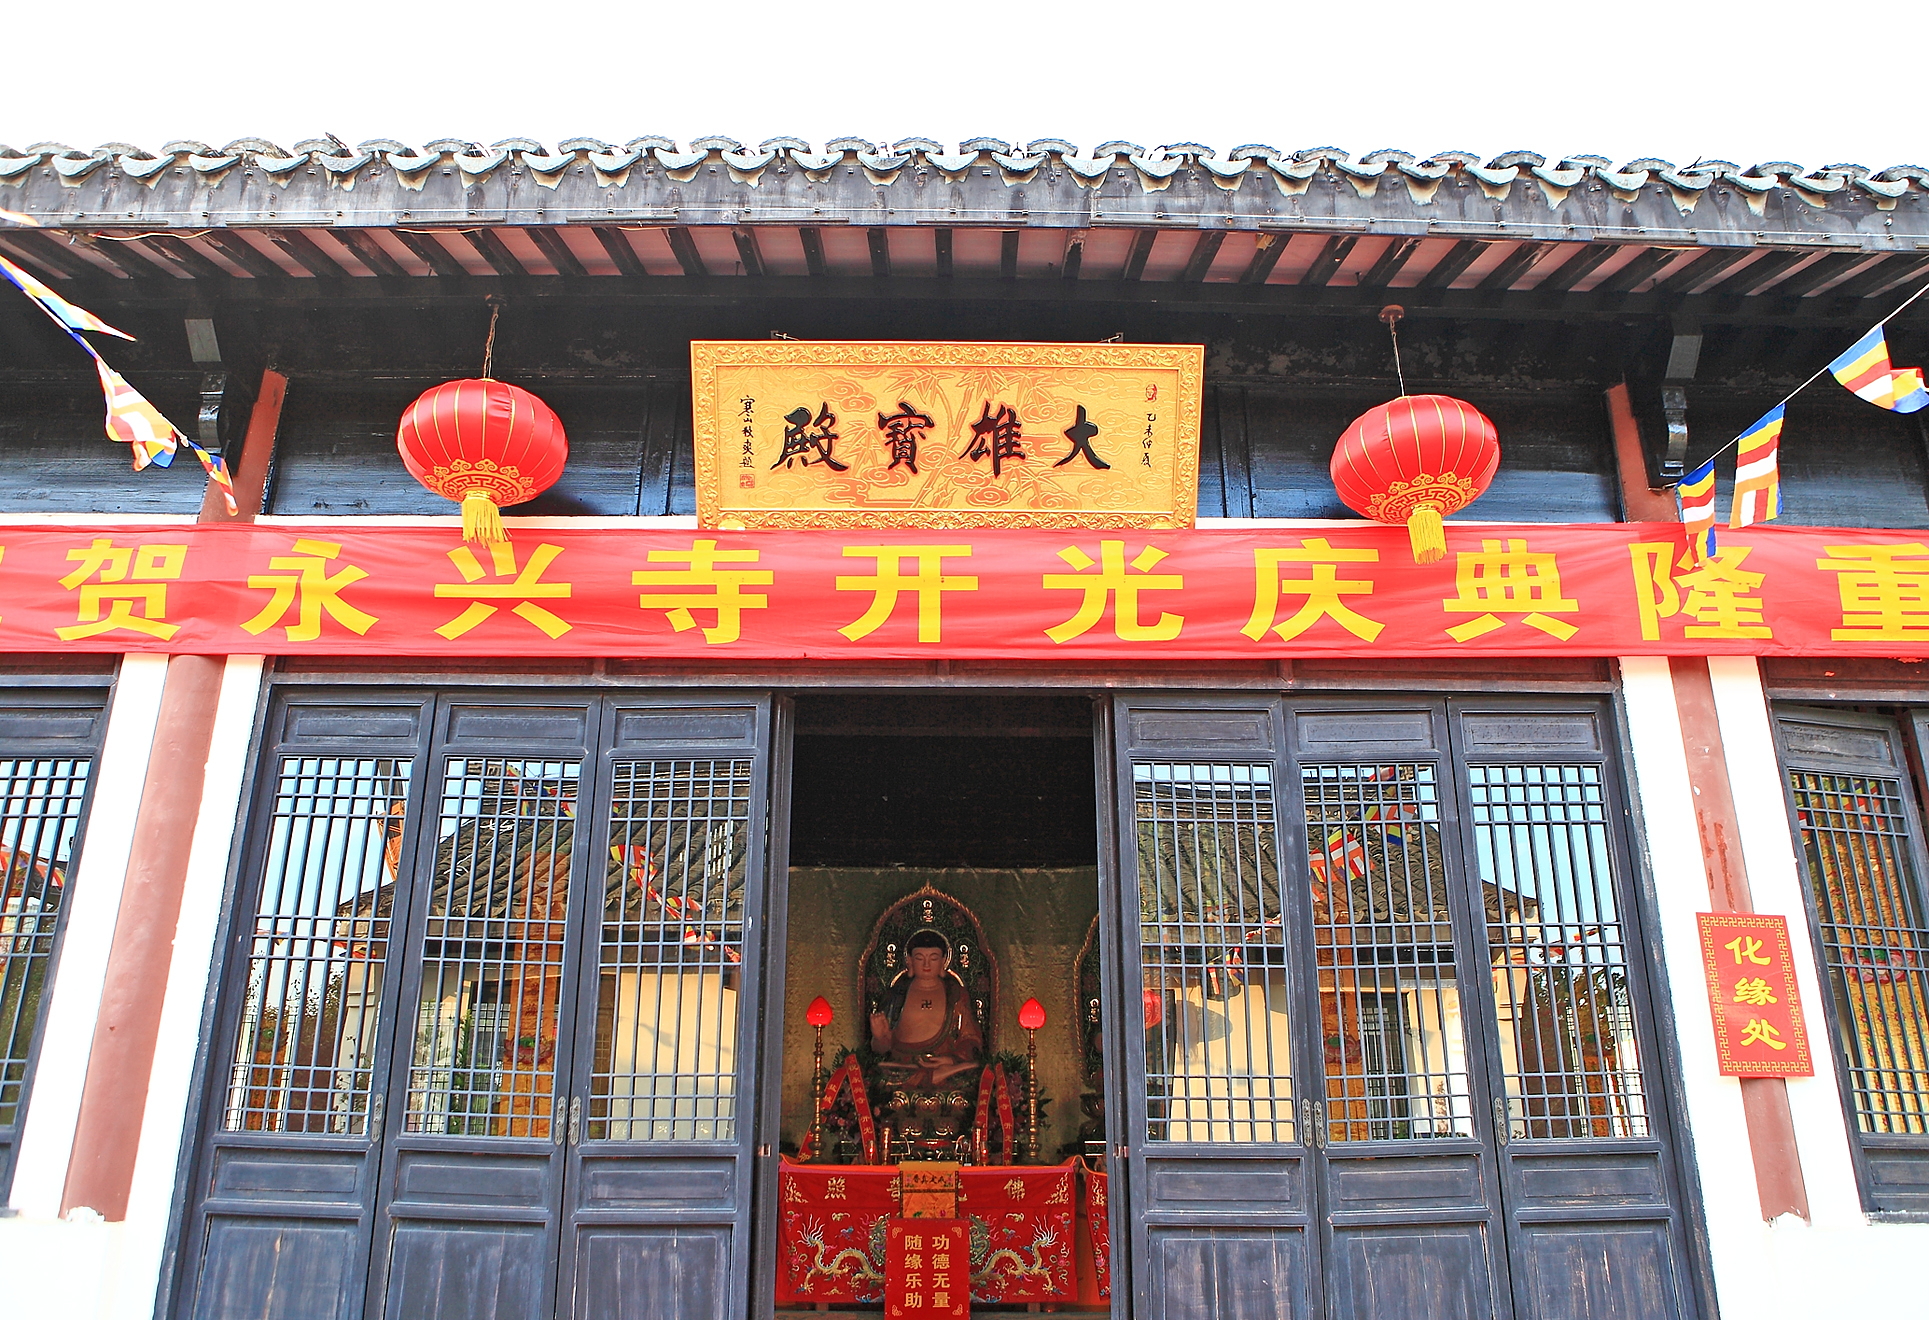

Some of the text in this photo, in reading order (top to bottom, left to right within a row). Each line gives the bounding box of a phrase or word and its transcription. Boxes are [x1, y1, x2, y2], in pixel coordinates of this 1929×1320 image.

[770, 401, 1111, 477] 大雄寶殿
[0, 536, 1929, 644] 贺永兴寺开光庆典隆重
[1724, 935, 1787, 1050] 化缘处
[904, 1233, 923, 1309] 随缘乐助
[931, 1233, 951, 1309] 功德无量
